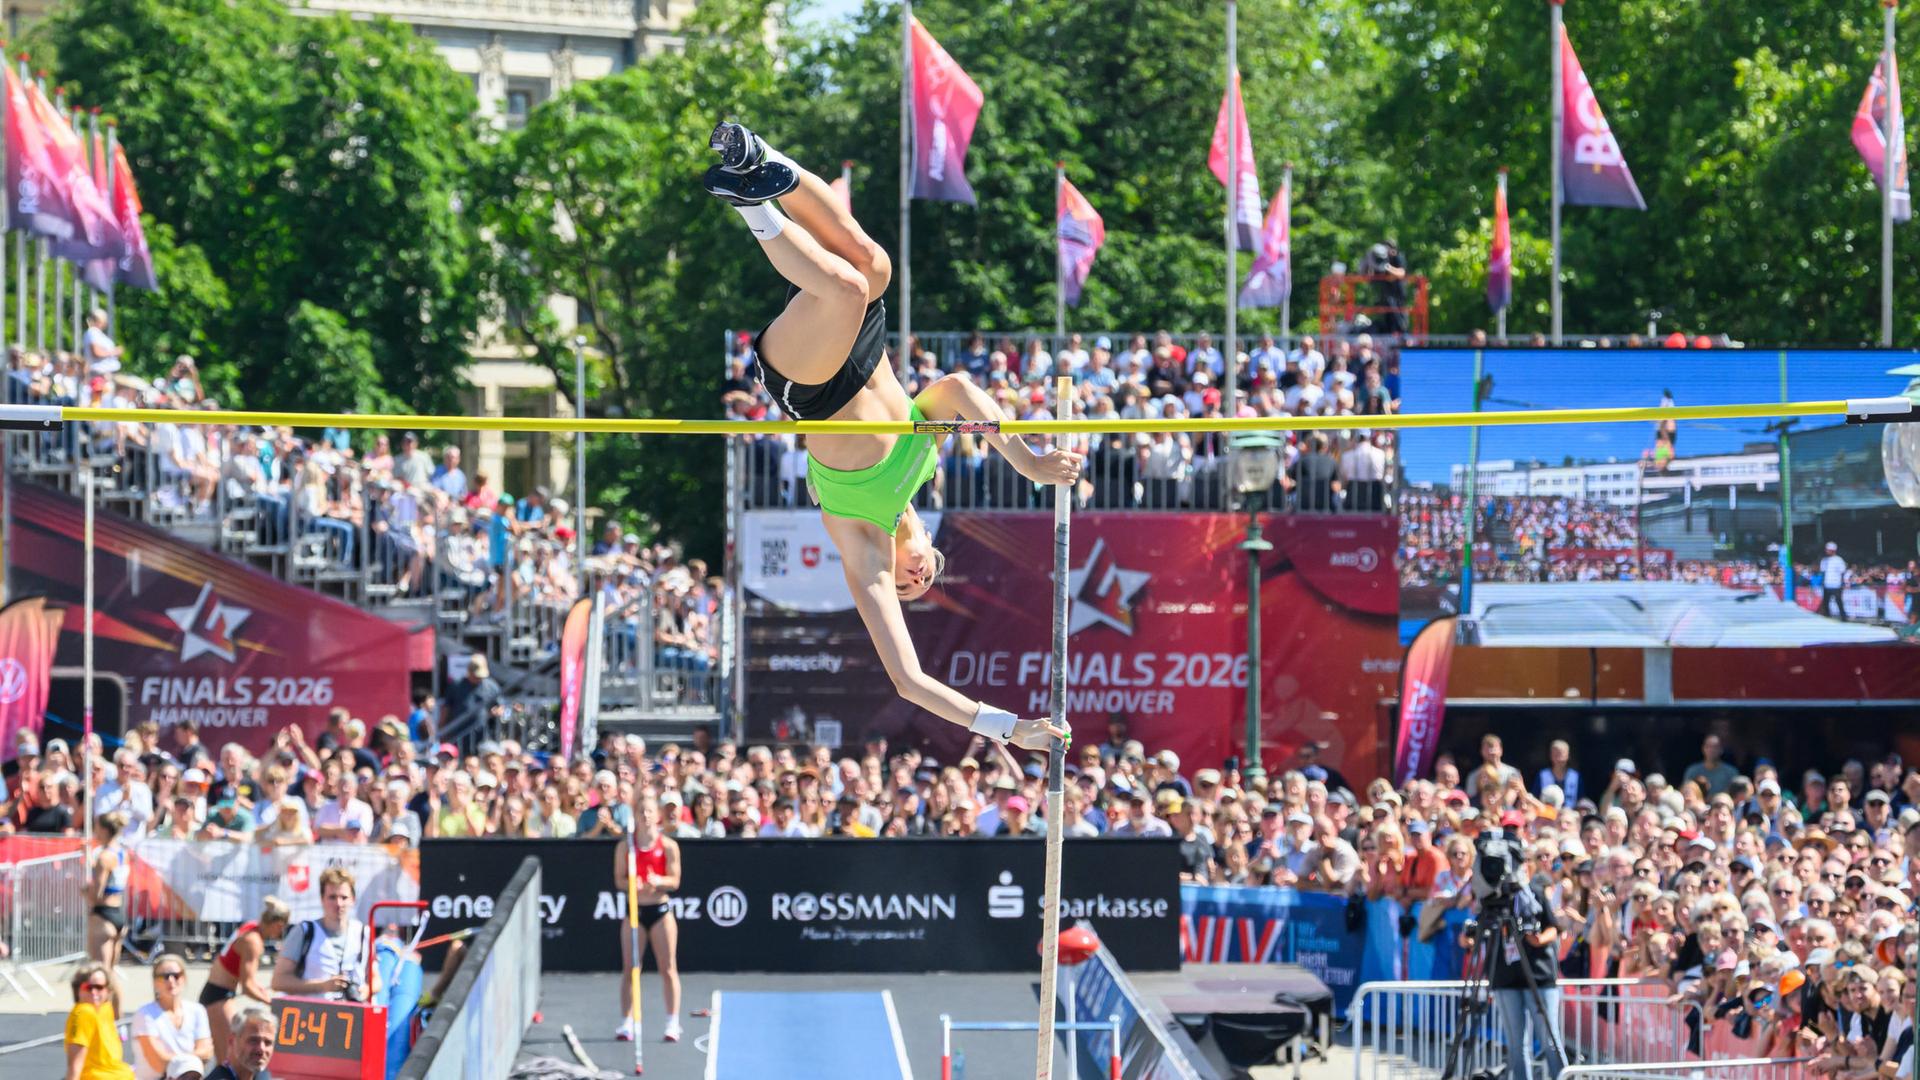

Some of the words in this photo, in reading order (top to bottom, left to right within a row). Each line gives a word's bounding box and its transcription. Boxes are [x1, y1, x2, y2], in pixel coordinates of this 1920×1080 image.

[916, 425, 955, 433] ESSX
[950, 651, 1009, 686] DIE
[1017, 652, 1156, 686] FINALS
[1162, 652, 1248, 687] 2026
[1361, 657, 1400, 673] ener
[141, 676, 252, 706] FINALS
[257, 676, 334, 706] 2026
[1028, 690, 1175, 714] HNNOVER
[150, 707, 268, 728] HANNOVER
[1405, 680, 1436, 781] ercity
[593, 891, 701, 920] Alnz
[772, 892, 956, 921] ROSSMANN
[278, 1006, 354, 1050] 0:47
